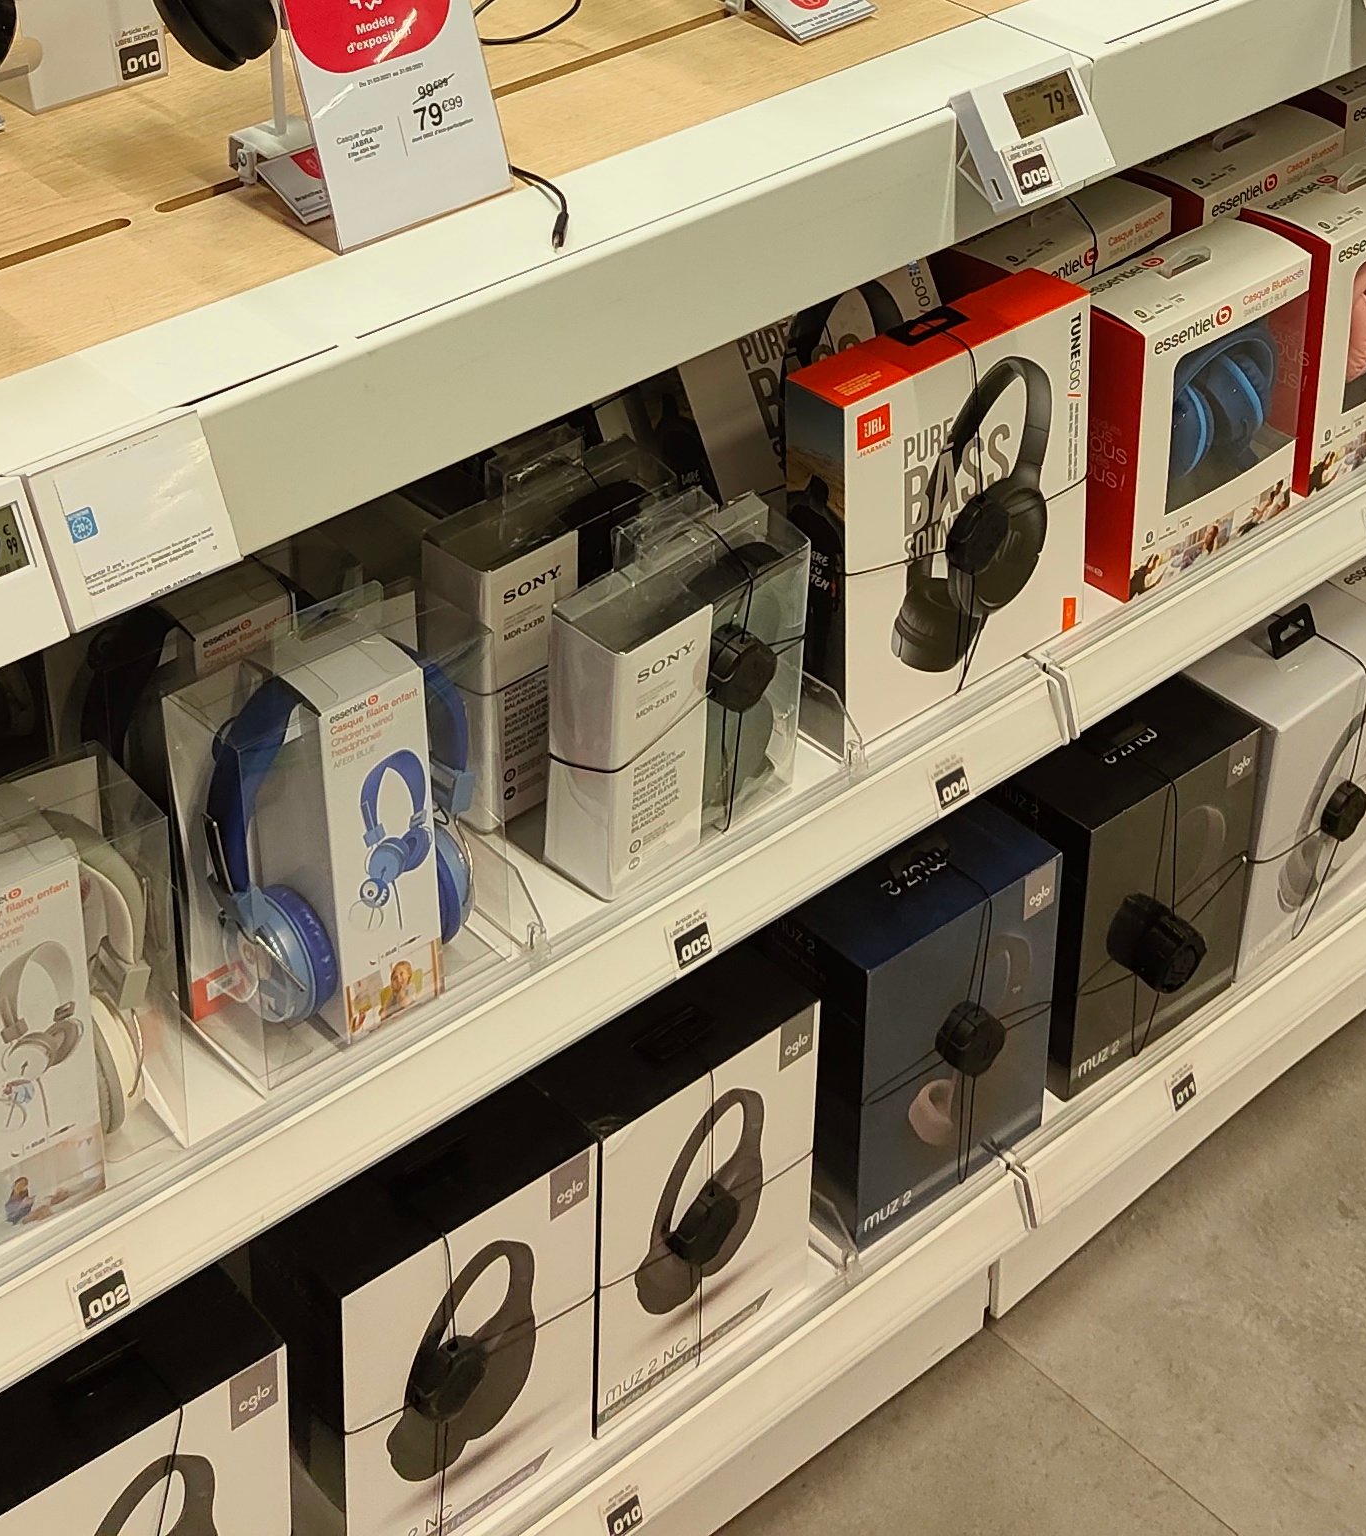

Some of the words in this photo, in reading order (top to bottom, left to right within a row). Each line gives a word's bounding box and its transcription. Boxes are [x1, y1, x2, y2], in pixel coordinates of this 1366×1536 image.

[122, 28, 141, 37] Article
[356, 15, 395, 34] Modèle
[115, 38, 132, 47] LIBRE
[134, 29, 158, 41] SERVICE
[413, 96, 463, 130] 79€99
[1044, 90, 1064, 113] 79
[336, 133, 359, 144] Casque
[361, 125, 383, 136] Casque
[351, 137, 373, 149] JABRA
[1211, 182, 1263, 218] essentiel
[863, 416, 885, 437] JBL
[904, 417, 954, 469] PURE
[904, 423, 1011, 536] BASS
[3, 524, 11, 536] €
[6, 537, 18, 555] 99
[503, 565, 561, 604] SONY
[203, 626, 240, 648] essentiel
[504, 616, 545, 642] MDR-ZX310
[637, 640, 695, 684] SONY
[330, 715, 363, 735] Casque
[366, 703, 389, 718] filaire
[391, 688, 418, 707] enfant
[330, 701, 367, 724] essentiel
[636, 690, 677, 720] MDR-ZX310
[331, 724, 371, 748] Children's
[372, 714, 394, 728] wired
[6, 897, 33, 913] filaire
[37, 880, 69, 899] enfant
[605, 1371, 641, 1406] muz
[648, 1360, 659, 1379] 2
[662, 1337, 690, 1368] NC
